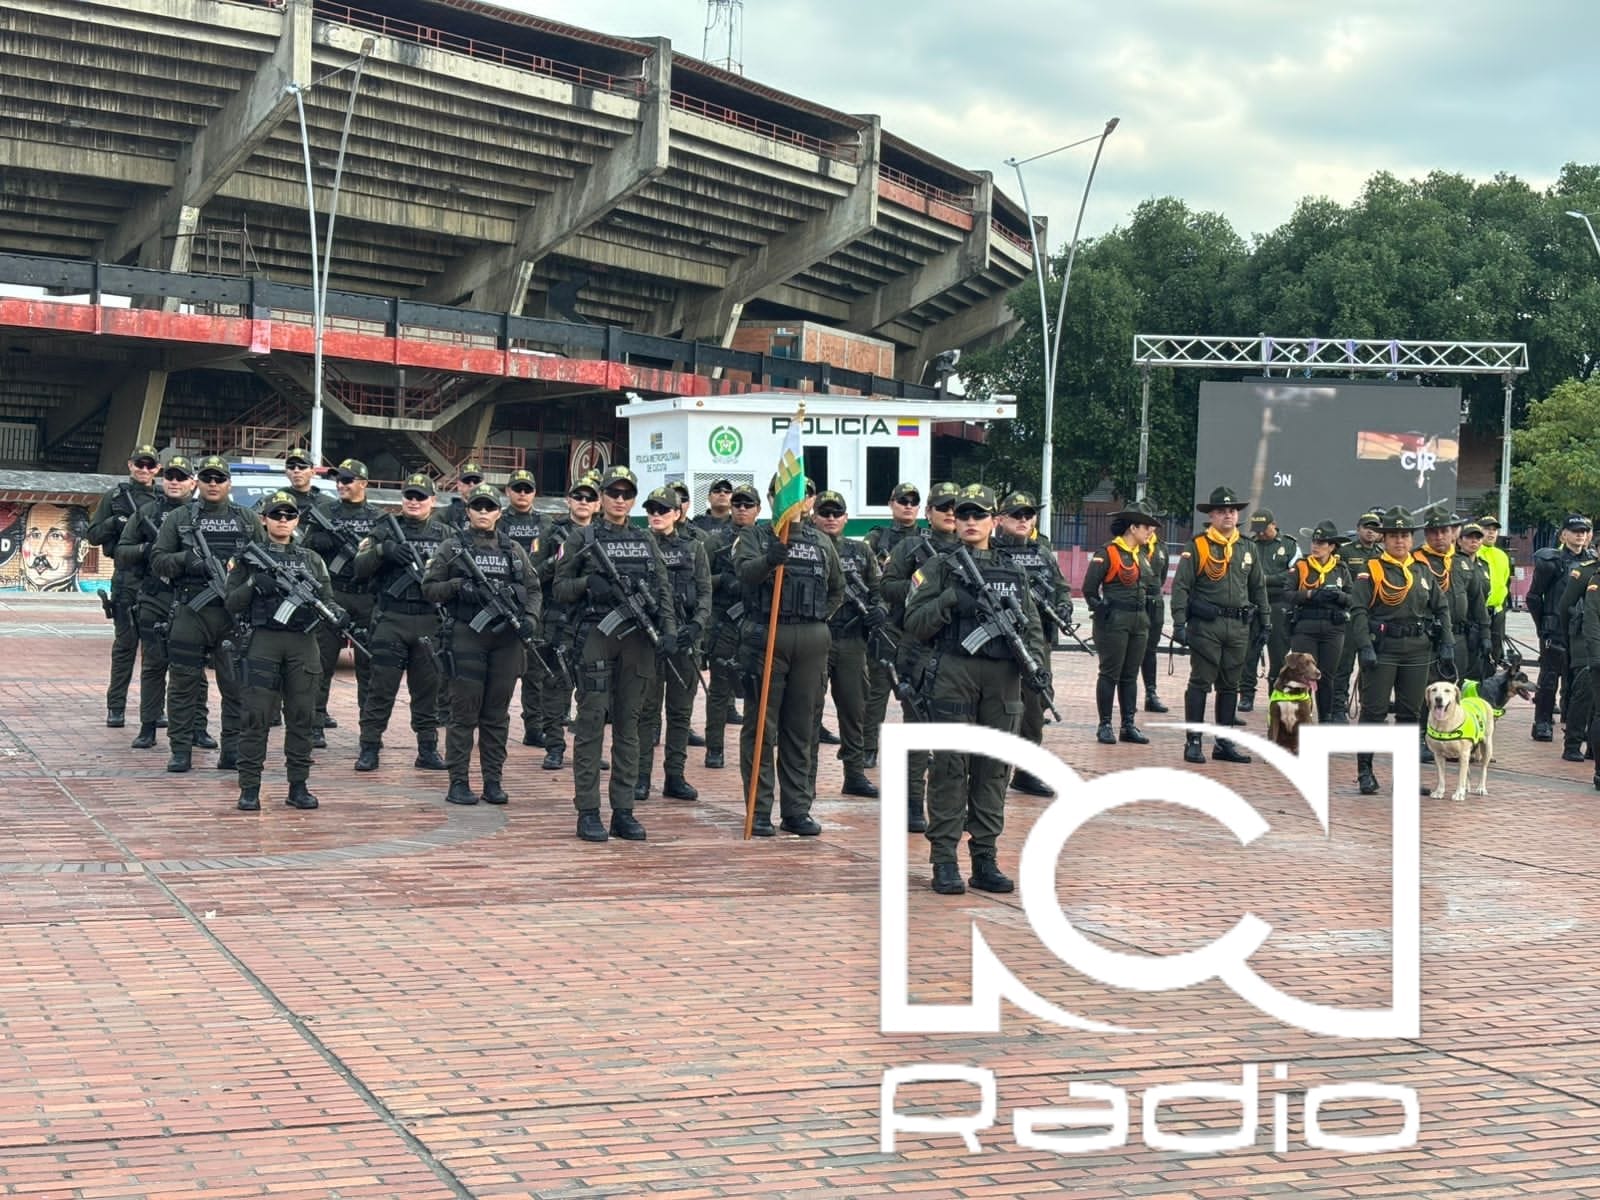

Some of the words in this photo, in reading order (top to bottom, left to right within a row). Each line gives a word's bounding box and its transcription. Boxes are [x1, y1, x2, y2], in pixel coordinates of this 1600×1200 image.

[771, 415, 890, 435] POLICÍA
[606, 549, 650, 557] POLICIA
[475, 555, 508, 567] GAULA
[986, 582, 1017, 592] AULA
